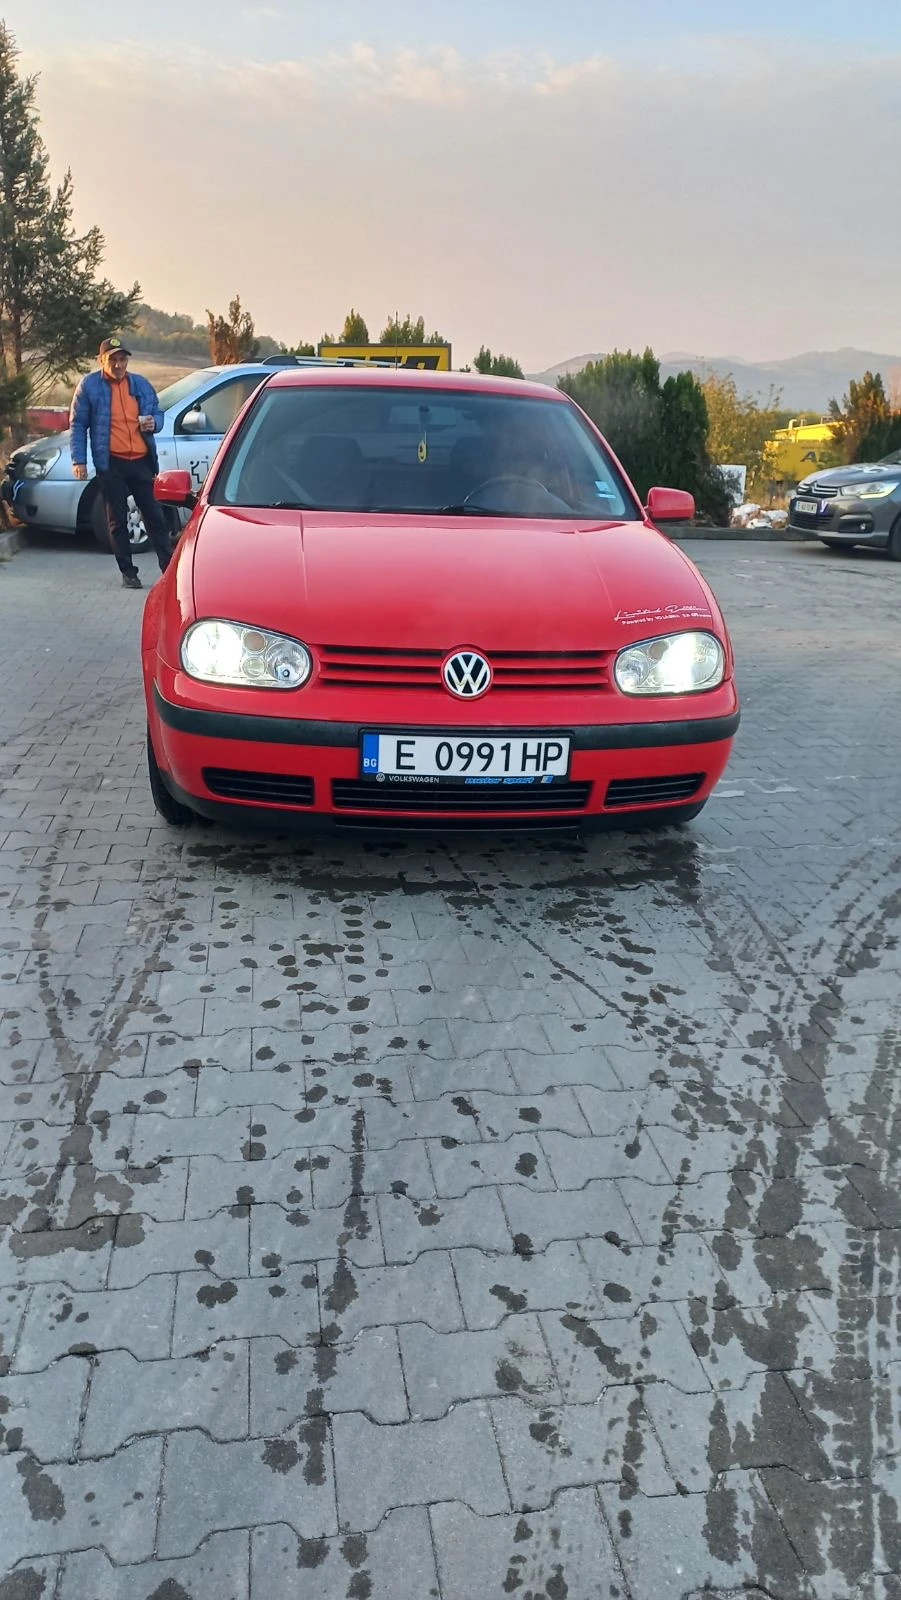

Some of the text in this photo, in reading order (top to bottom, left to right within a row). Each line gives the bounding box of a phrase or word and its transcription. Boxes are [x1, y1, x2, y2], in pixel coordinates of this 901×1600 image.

[395, 740, 416, 771] E
[363, 758, 377, 768] BG
[388, 775, 440, 783] VOLKSWAGEN
